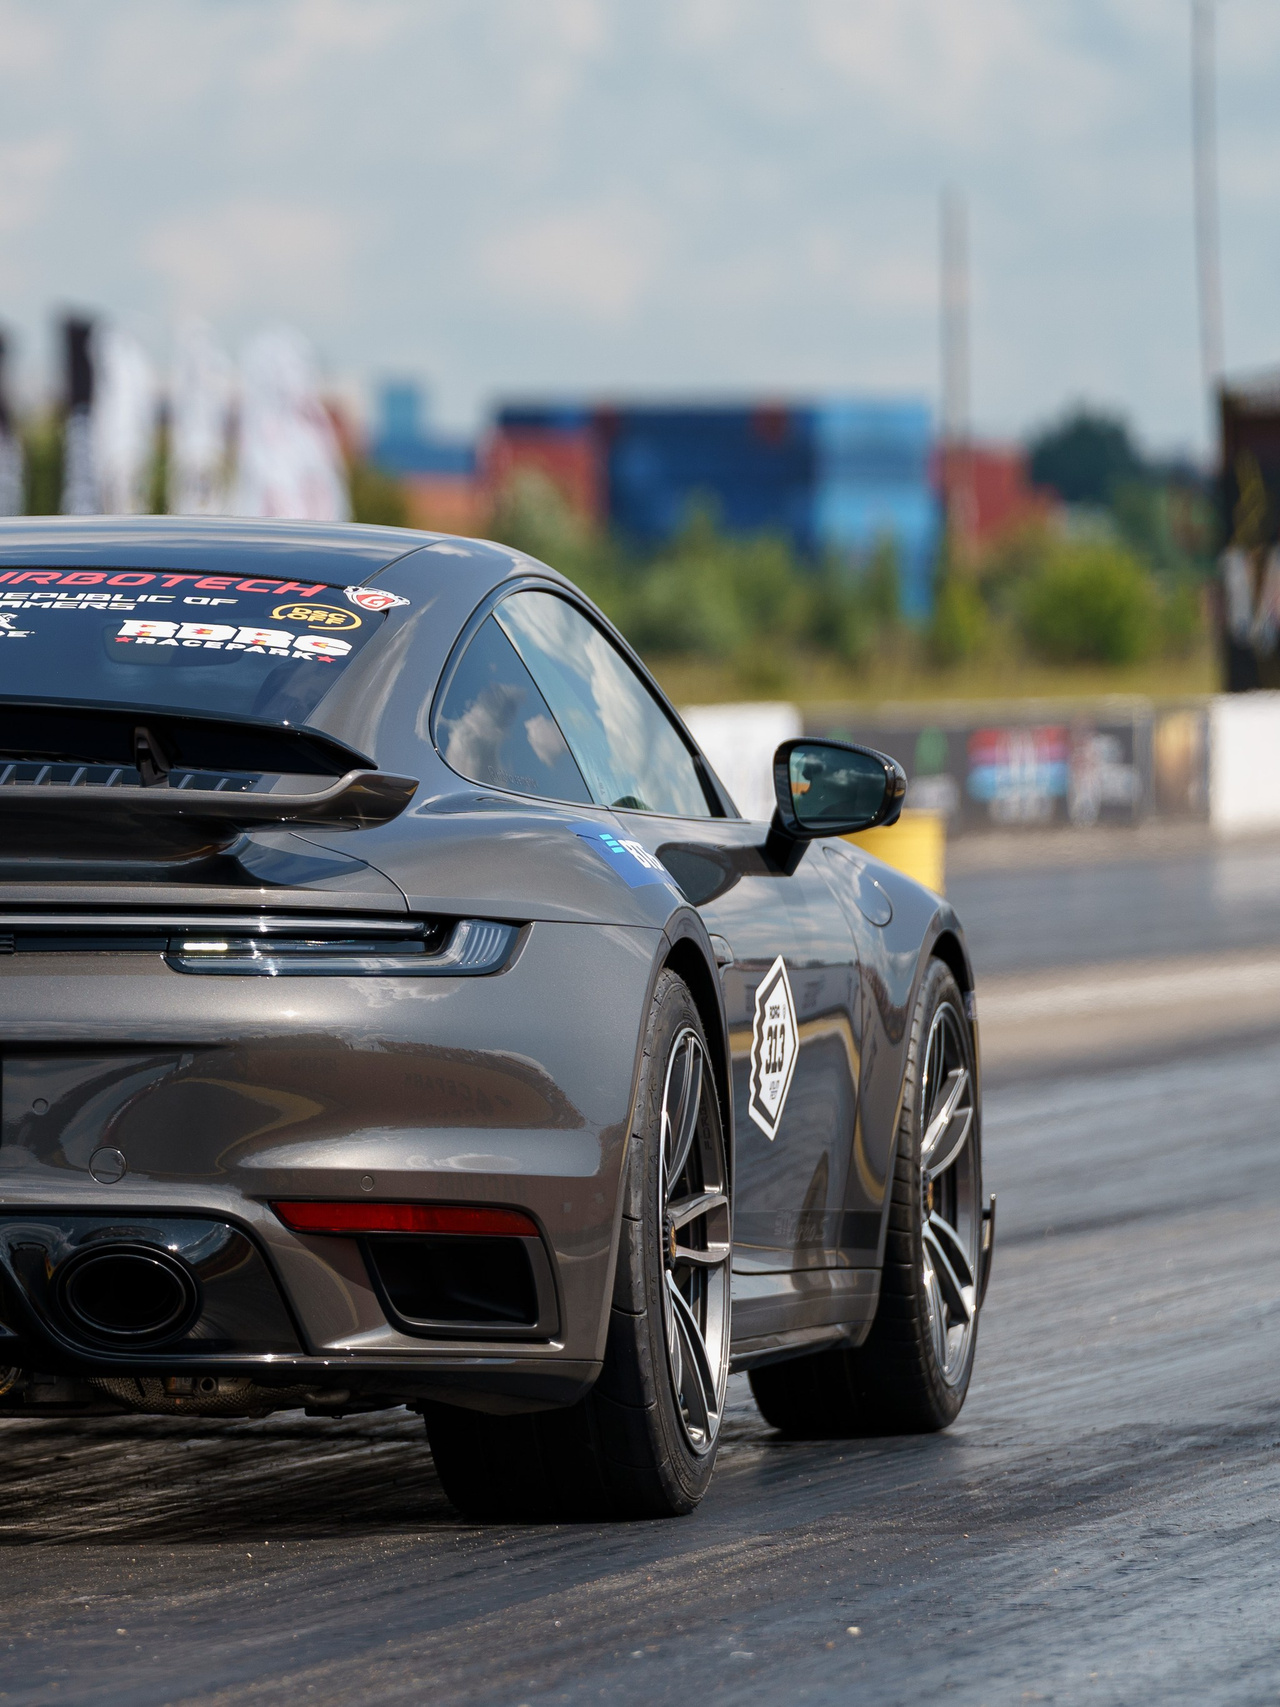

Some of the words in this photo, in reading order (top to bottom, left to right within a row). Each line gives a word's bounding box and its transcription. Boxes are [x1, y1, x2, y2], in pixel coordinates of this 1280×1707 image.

[182, 596, 239, 606] OF
[286, 612, 346, 625] OFF
[291, 607, 348, 619] DSC
[135, 635, 318, 661] RACEPARK
[765, 1022, 786, 1075] 313
